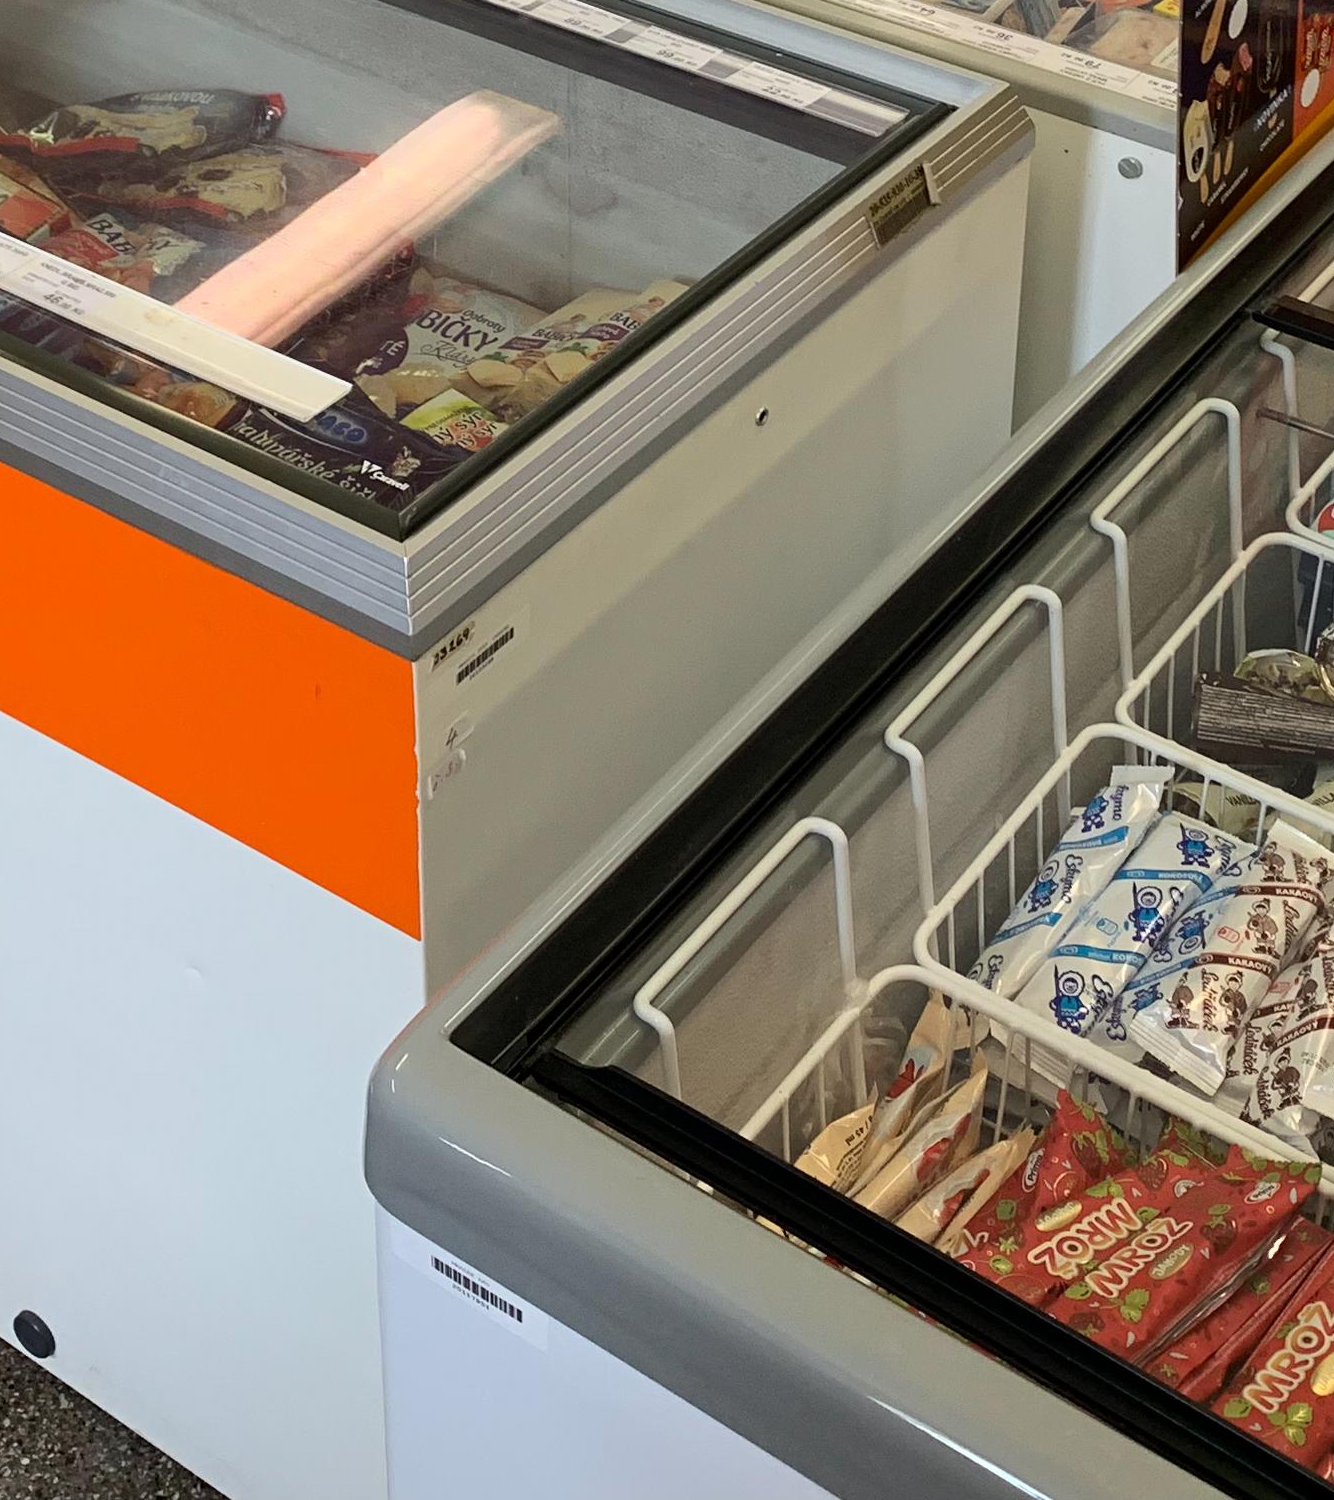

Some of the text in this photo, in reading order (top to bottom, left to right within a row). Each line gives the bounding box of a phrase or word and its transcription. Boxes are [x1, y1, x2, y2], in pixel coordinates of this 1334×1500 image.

[422, 308, 500, 362] BIČKY
[371, 469, 410, 491] Caravell
[1199, 967, 1218, 1035] Ledňáček
[1026, 1152, 1043, 1187] Prima
